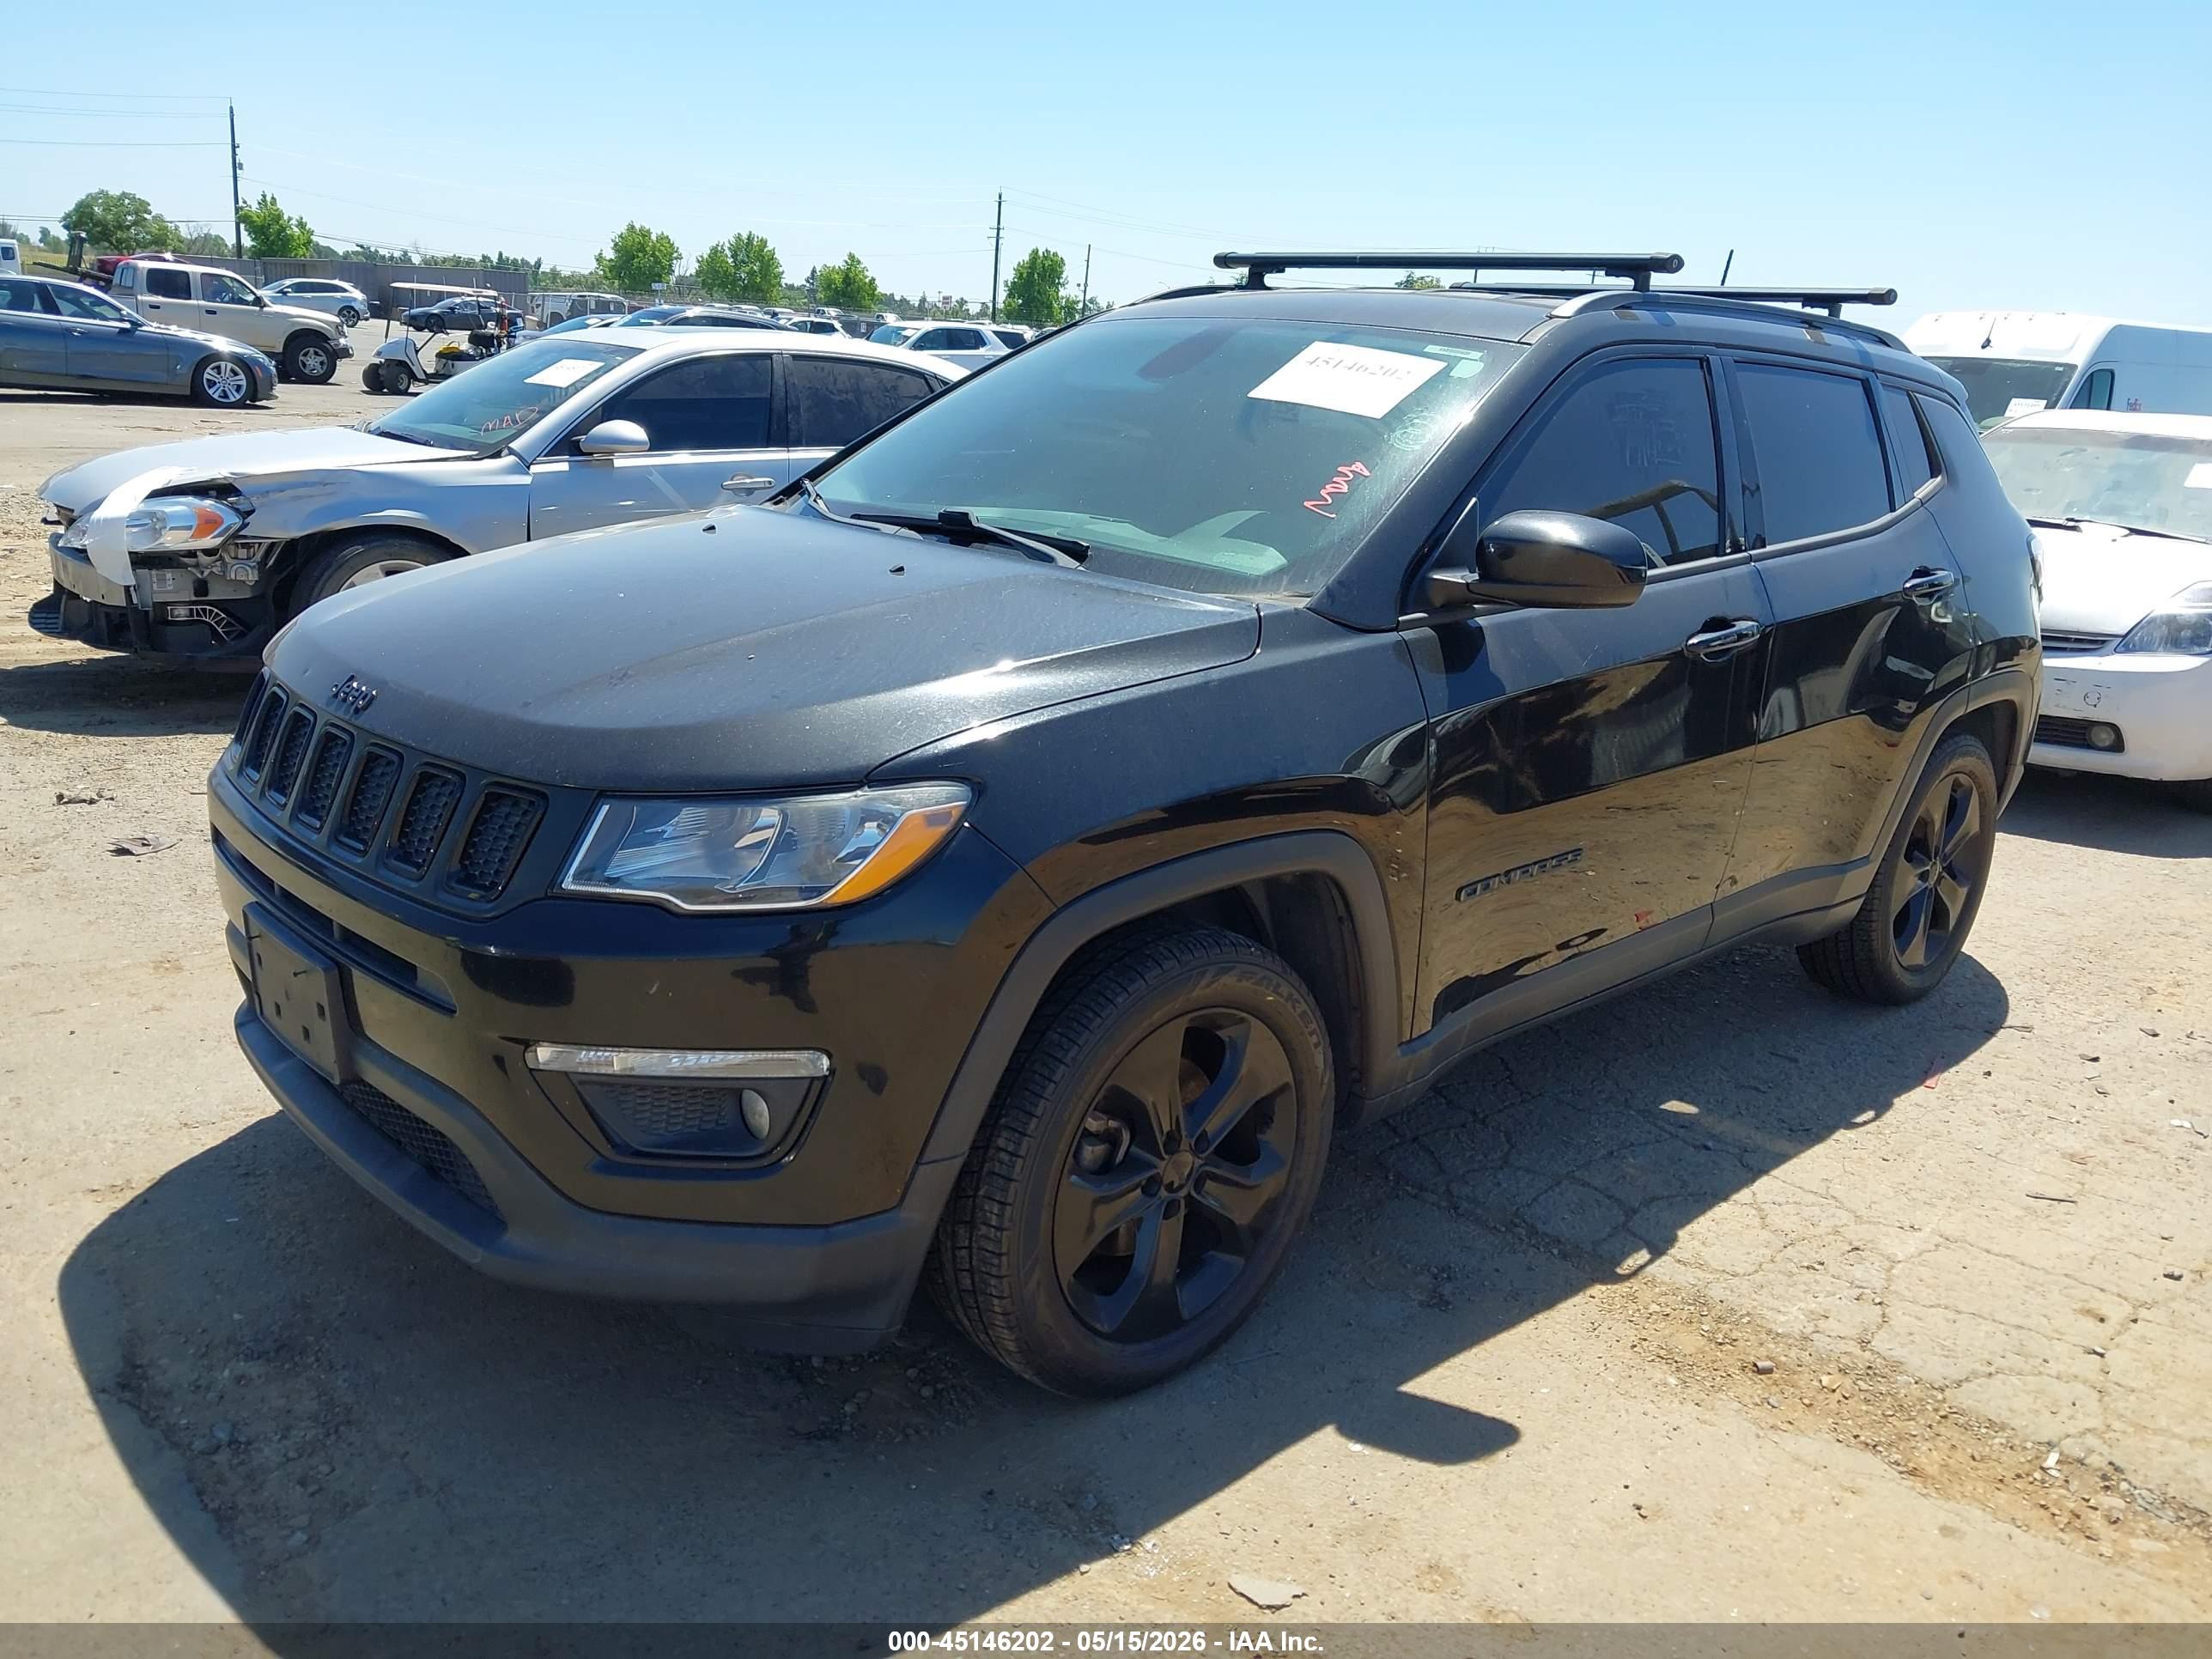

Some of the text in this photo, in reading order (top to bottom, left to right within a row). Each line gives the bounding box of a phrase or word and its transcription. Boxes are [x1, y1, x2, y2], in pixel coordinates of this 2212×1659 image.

[1305, 356, 1413, 380] 45146202
[330, 672, 378, 714] Jeep
[1455, 847, 1583, 902] COMPASS
